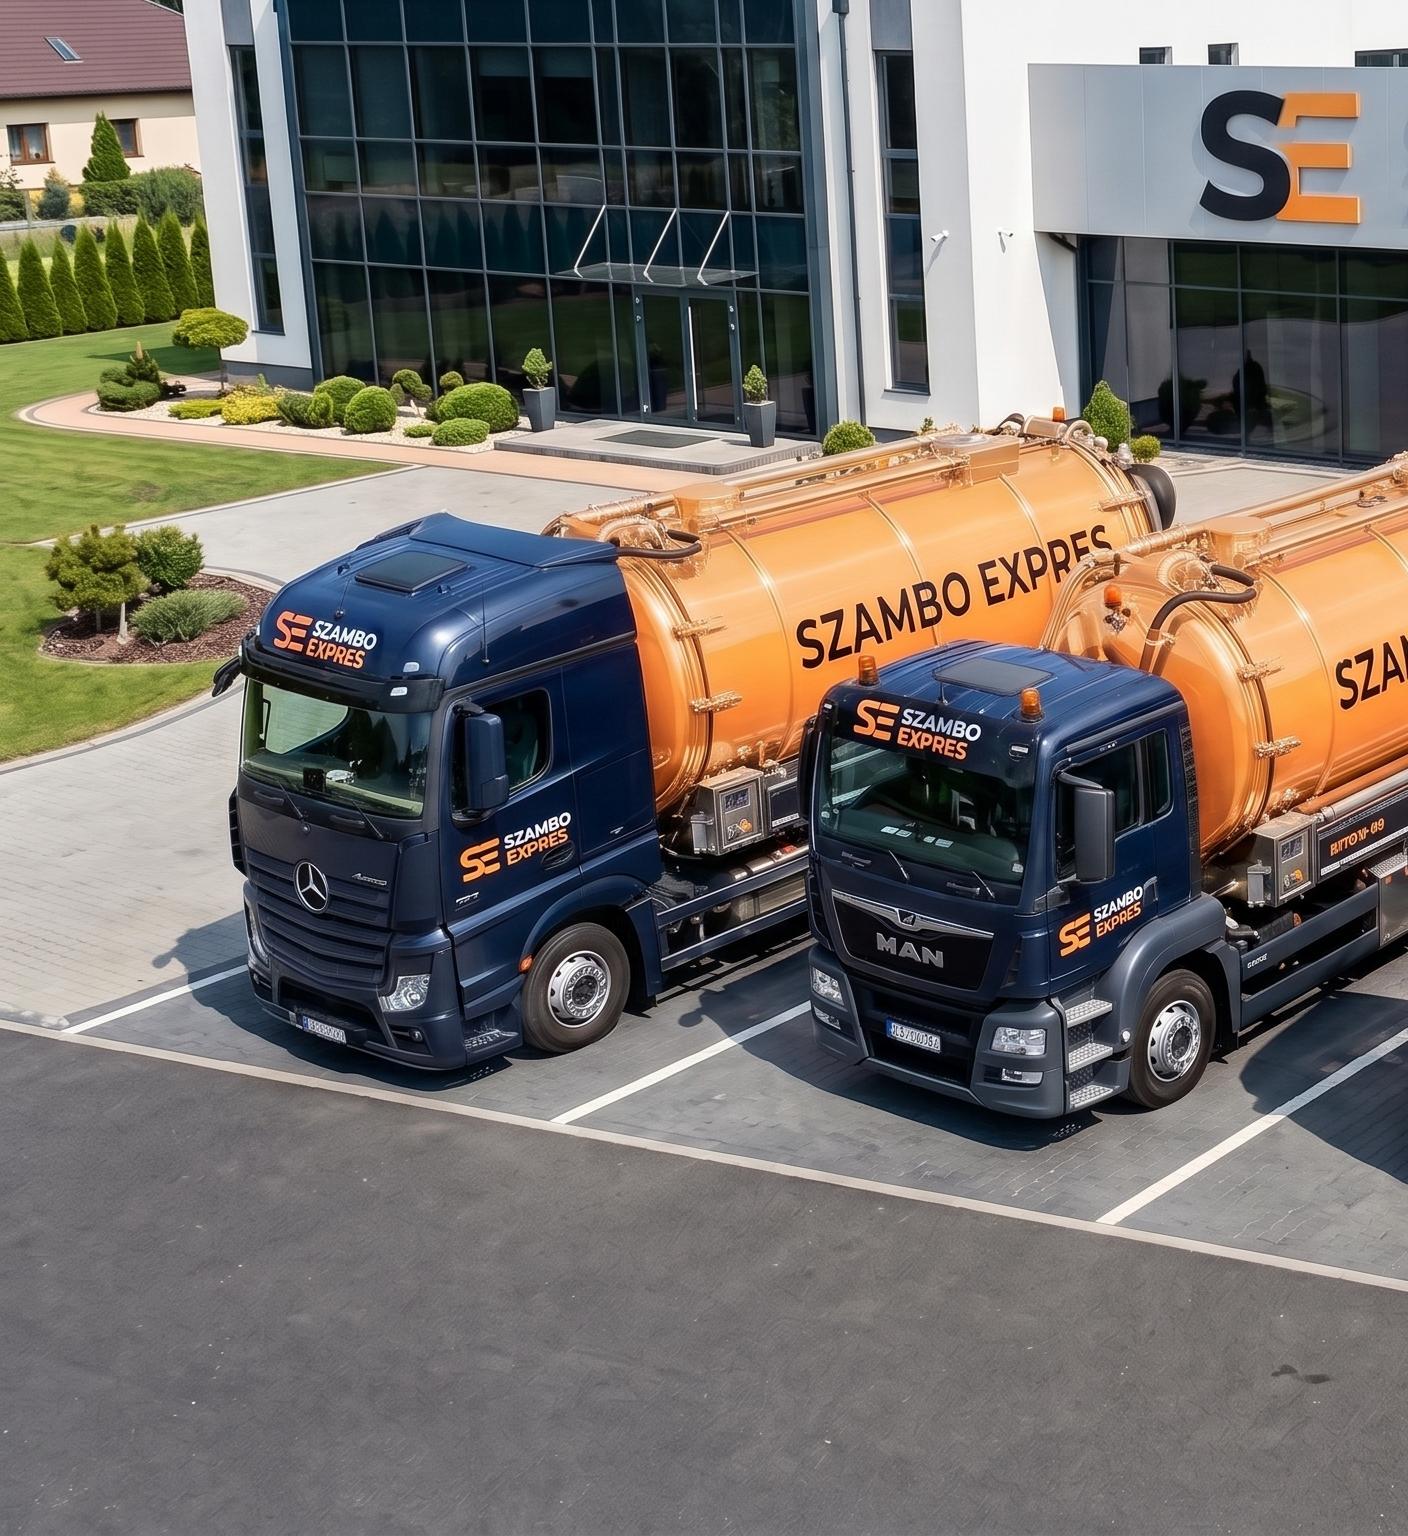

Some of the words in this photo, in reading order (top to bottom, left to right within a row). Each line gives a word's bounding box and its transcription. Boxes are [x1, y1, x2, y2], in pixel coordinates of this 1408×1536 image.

[1199, 90, 1363, 224] SE
[273, 610, 314, 652] SE
[312, 620, 377, 650] SZAMBO
[796, 572, 971, 669] SZAMBO
[306, 638, 366, 669] EXPRES
[853, 699, 901, 741] SE
[901, 708, 982, 741] SZAMBO
[897, 727, 968, 760] EXPRES
[503, 812, 572, 849] SZAMBO
[506, 828, 569, 866] EXPRES
[460, 837, 501, 883] SE
[1094, 886, 1143, 922] SZAMBO
[876, 932, 944, 968] MAN
[1059, 913, 1091, 957] SE
